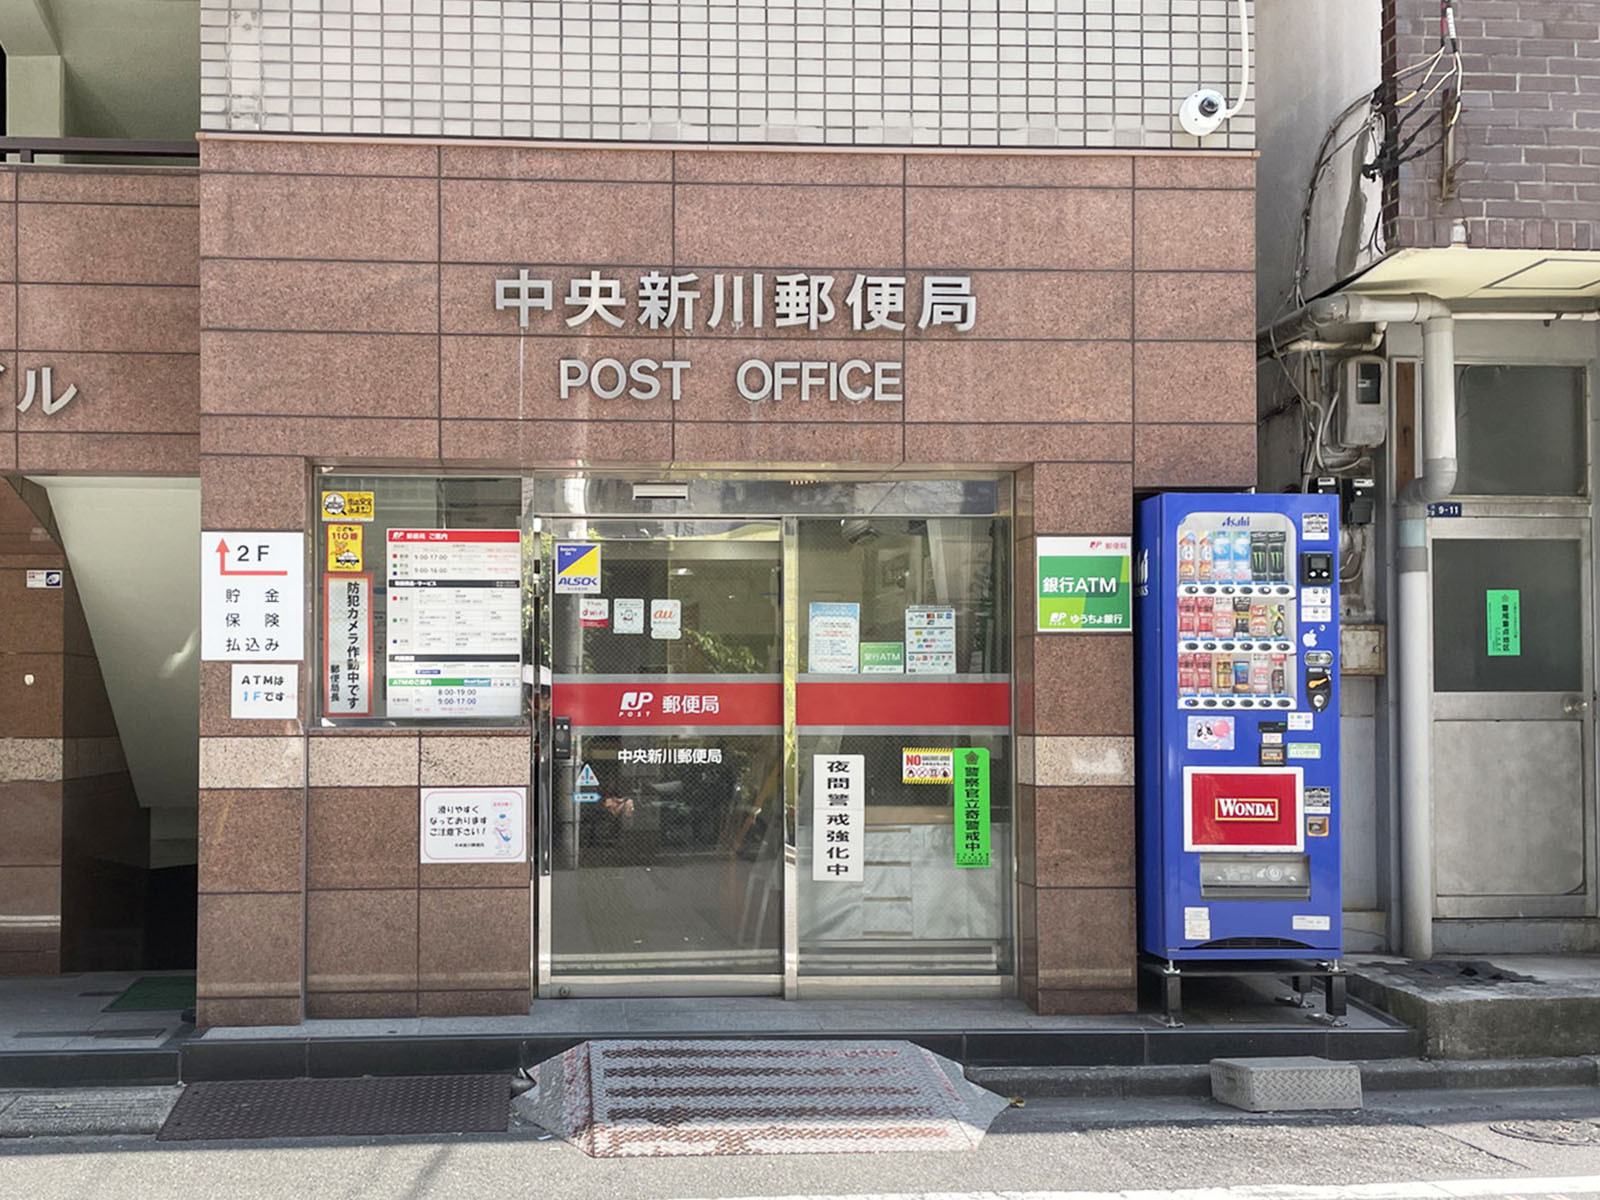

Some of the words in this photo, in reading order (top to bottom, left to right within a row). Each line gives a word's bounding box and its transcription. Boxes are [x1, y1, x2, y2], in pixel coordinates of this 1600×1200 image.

[495, 268, 977, 333] 中央新川郵便局
[559, 359, 691, 401] POST
[736, 359, 903, 403] OFFICE
[1438, 505, 1459, 515] 9-11
[1222, 516, 1250, 527] Asahi
[558, 577, 598, 586] ALSOK
[1042, 576, 1117, 594] 銀行ATM
[225, 588, 280, 604] 貯金
[225, 612, 280, 628] 保険
[653, 610, 673, 620] au
[1070, 613, 1123, 625] ゆうちょ銀行
[225, 637, 280, 653] 払込み
[346, 581, 361, 710] 防犯カメラ作動中です
[241, 674, 285, 686] ATMは
[662, 695, 720, 714] 郵便局
[617, 748, 723, 765] 中央新川郵便局
[906, 755, 921, 766] NO
[964, 766, 981, 852] 警察官立寄警戒中
[826, 760, 851, 876] 夜間警戒強化中
